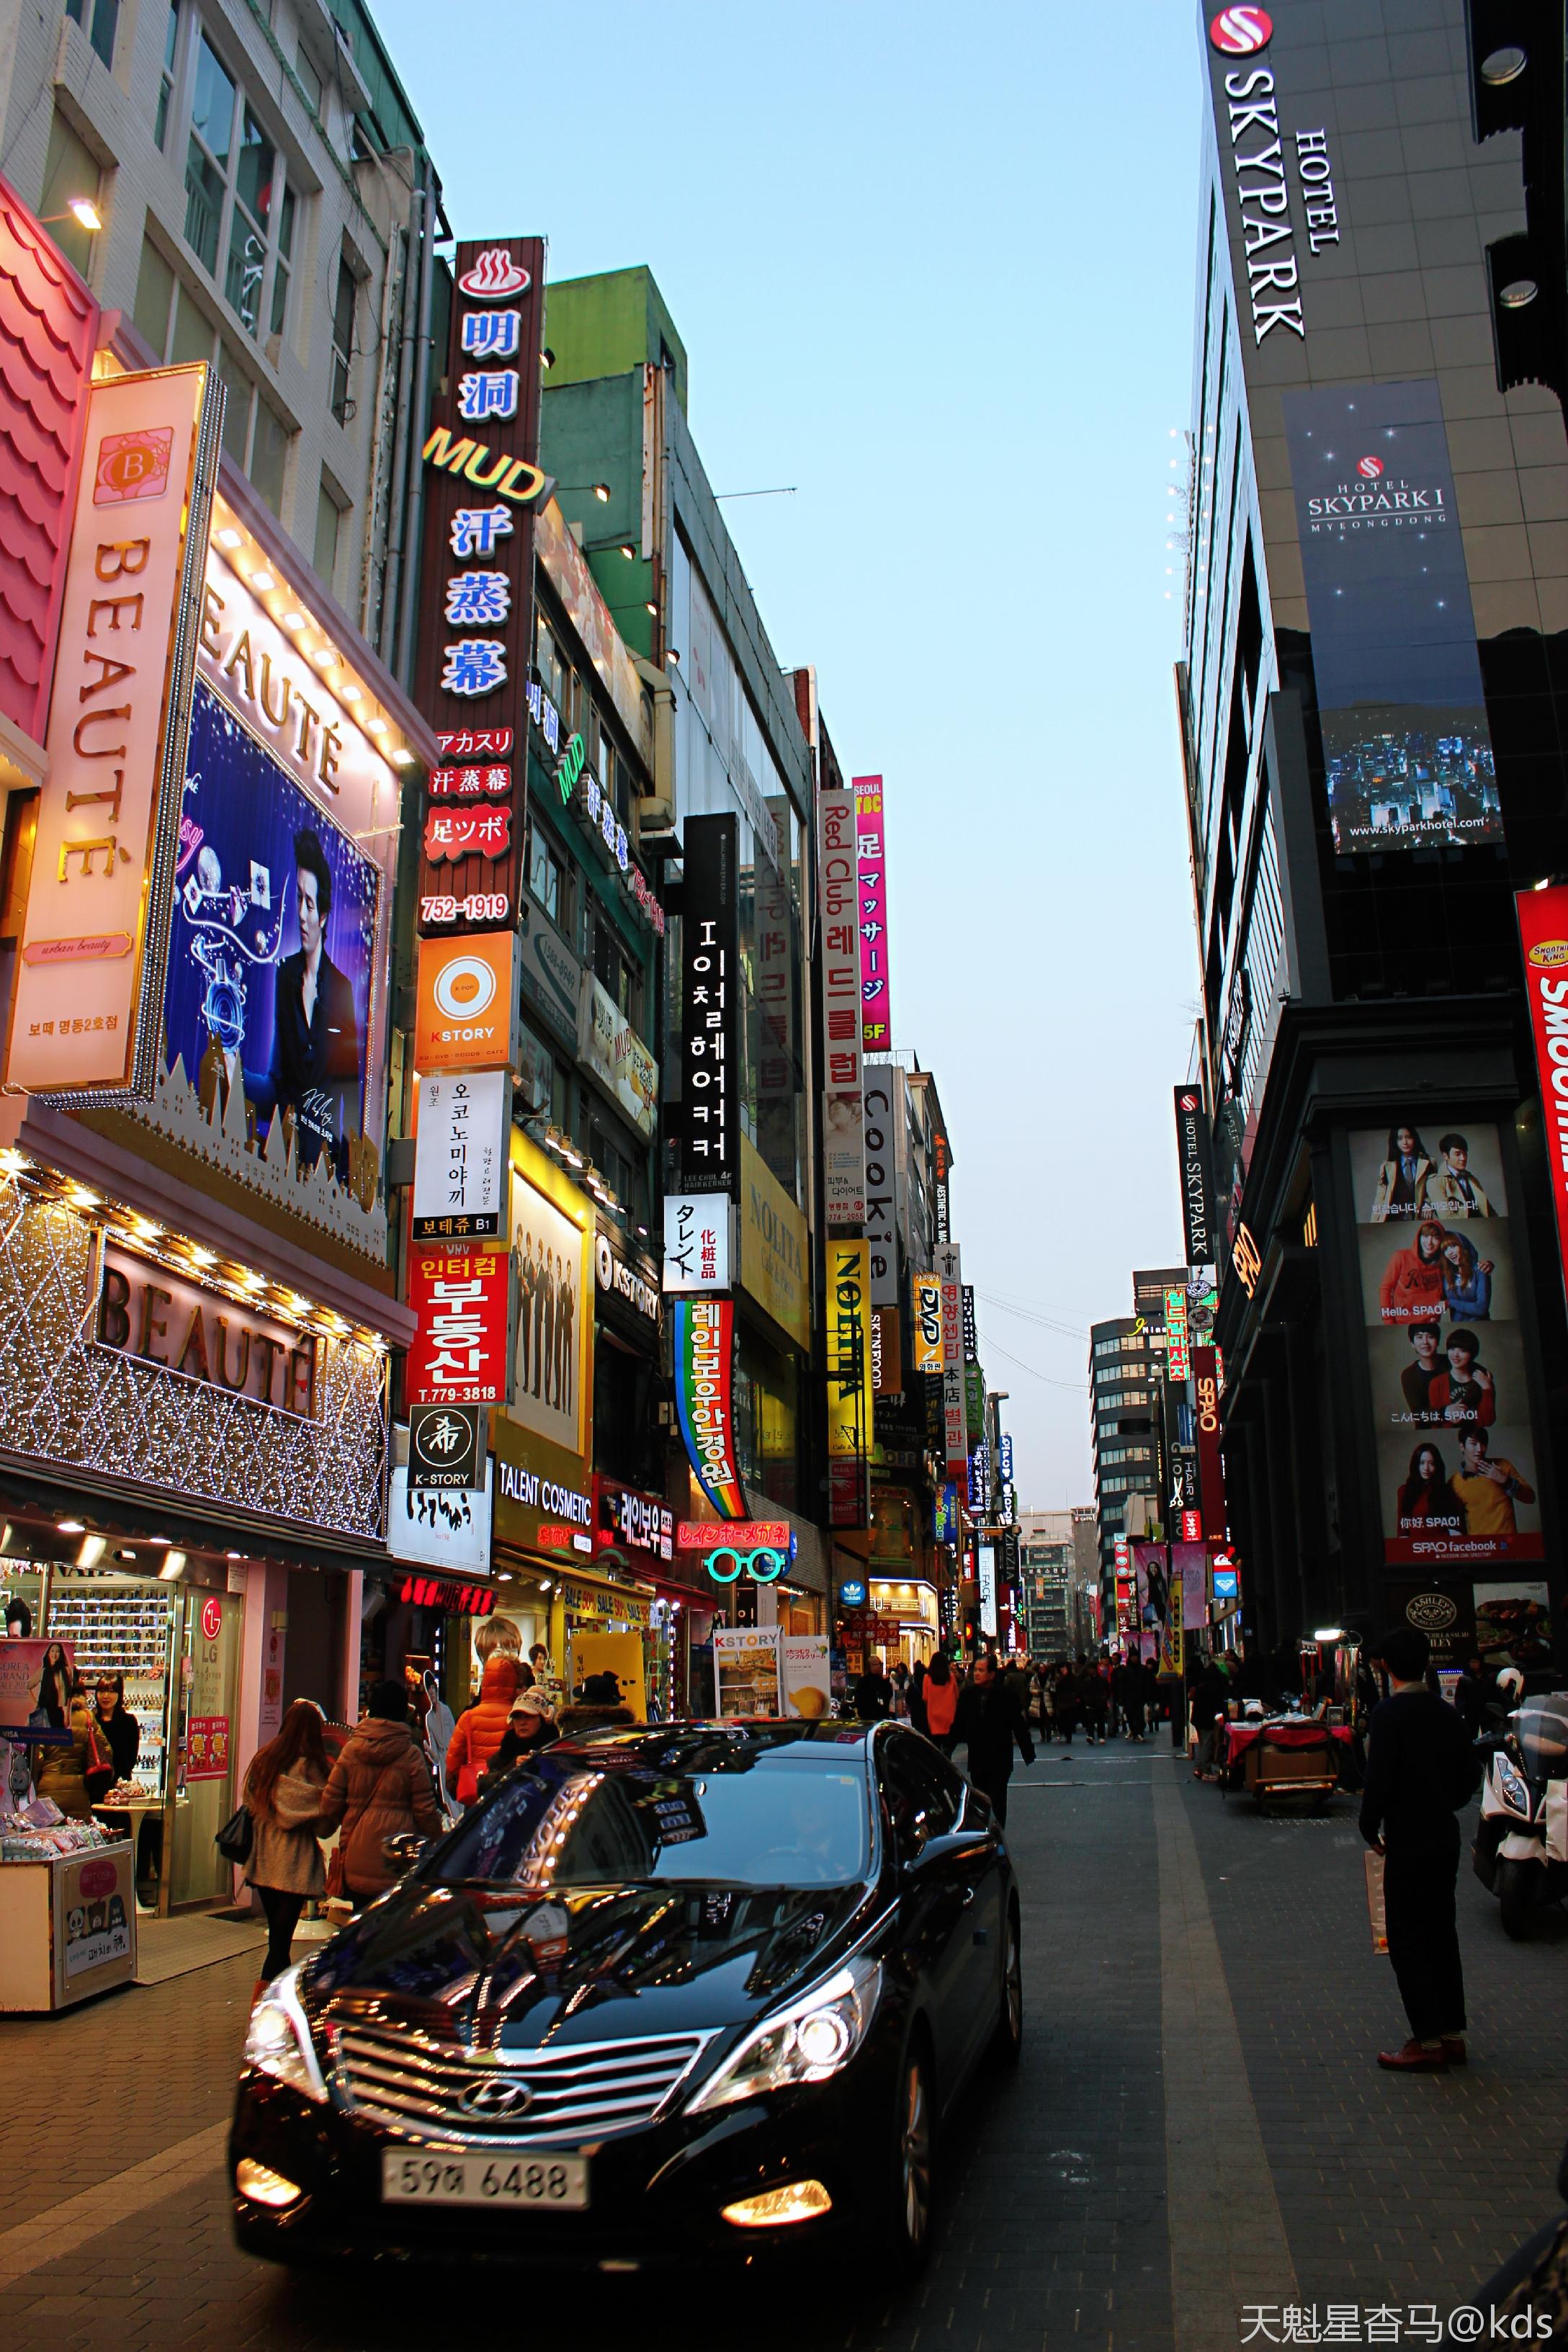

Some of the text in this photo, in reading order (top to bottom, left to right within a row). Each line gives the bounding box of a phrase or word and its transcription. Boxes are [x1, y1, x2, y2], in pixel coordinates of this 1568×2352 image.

[1224, 70, 1305, 348] SKYPARK
[1296, 128, 1340, 256] HOTEL
[458, 311, 521, 421] 明洞
[422, 427, 546, 503] MUD
[1338, 480, 1410, 495] HOTEL
[1311, 514, 1446, 532] MYEONGDONG
[441, 504, 514, 696] 汗蒸幕
[200, 586, 340, 795] EAUTÉ
[58, 536, 150, 884] BEAUTÉ
[437, 732, 510, 754] アカスリ
[433, 769, 508, 792] 汗蒸幕
[557, 733, 586, 805] MUD
[854, 784, 881, 795] SEOUL
[431, 817, 503, 843] 足ツボ
[825, 805, 852, 850] Red
[1350, 817, 1484, 837] www.skyparkhotel.com
[825, 859, 853, 916] Club
[422, 894, 509, 922] 752-1919
[42, 939, 112, 955] urban beauty
[28, 1015, 118, 1036] 보떼 명동2호점
[431, 1027, 494, 1042] KSTORY
[863, 1025, 885, 1039] 5F
[614, 1026, 632, 1065] MUD
[691, 950, 725, 1161] 이철헤어커커
[448, 1083, 470, 1207] 오코노미야끼
[721, 1171, 732, 1180] 4F
[833, 1186, 864, 1197] 다이어트
[1186, 1117, 1208, 1256] HOTEL SKYPARK
[936, 1184, 946, 1221] AESTHETIC
[421, 1217, 489, 1235] 보테쥬 B1
[670, 1204, 694, 1279] タレント
[750, 1183, 802, 1282] NOLITA
[421, 1256, 496, 1279] 인터컴
[701, 1229, 716, 1279] 化粧品
[614, 1259, 658, 1320] KSTORY
[1381, 1305, 1446, 1318] Hello, SPAO!
[424, 1279, 489, 1384] 부동산
[871, 1315, 882, 1389] SKINFOOD
[942, 1284, 963, 1448] 영양센터 本店 별관
[418, 1386, 496, 1403] T.779-3818
[691, 1302, 735, 1489] 레인보우안경원
[1199, 1377, 1217, 1431] SPAO
[1391, 1410, 1478, 1423] こんにちは, SPAO!
[415, 1474, 470, 1485] K-STORY
[500, 1462, 592, 1526] TALENT COSMETIC
[1185, 1462, 1194, 1495] HAIR
[621, 1492, 660, 1554] 레인보우
[678, 1524, 787, 1544] レインボーメガネ
[1426, 1516, 1460, 1528] SPAO!
[1412, 1540, 1497, 1554] SPAO facebook
[565, 1586, 581, 1609] SALE
[582, 1590, 596, 1613] 50%
[597, 1593, 613, 1614] SALE
[627, 1603, 641, 1622] SALE
[1414, 1596, 1448, 1610] ASHLEY
[202, 1645, 218, 1663] LG
[714, 1634, 778, 1648] KSTORY
[480, 2163, 568, 2199] 6488
